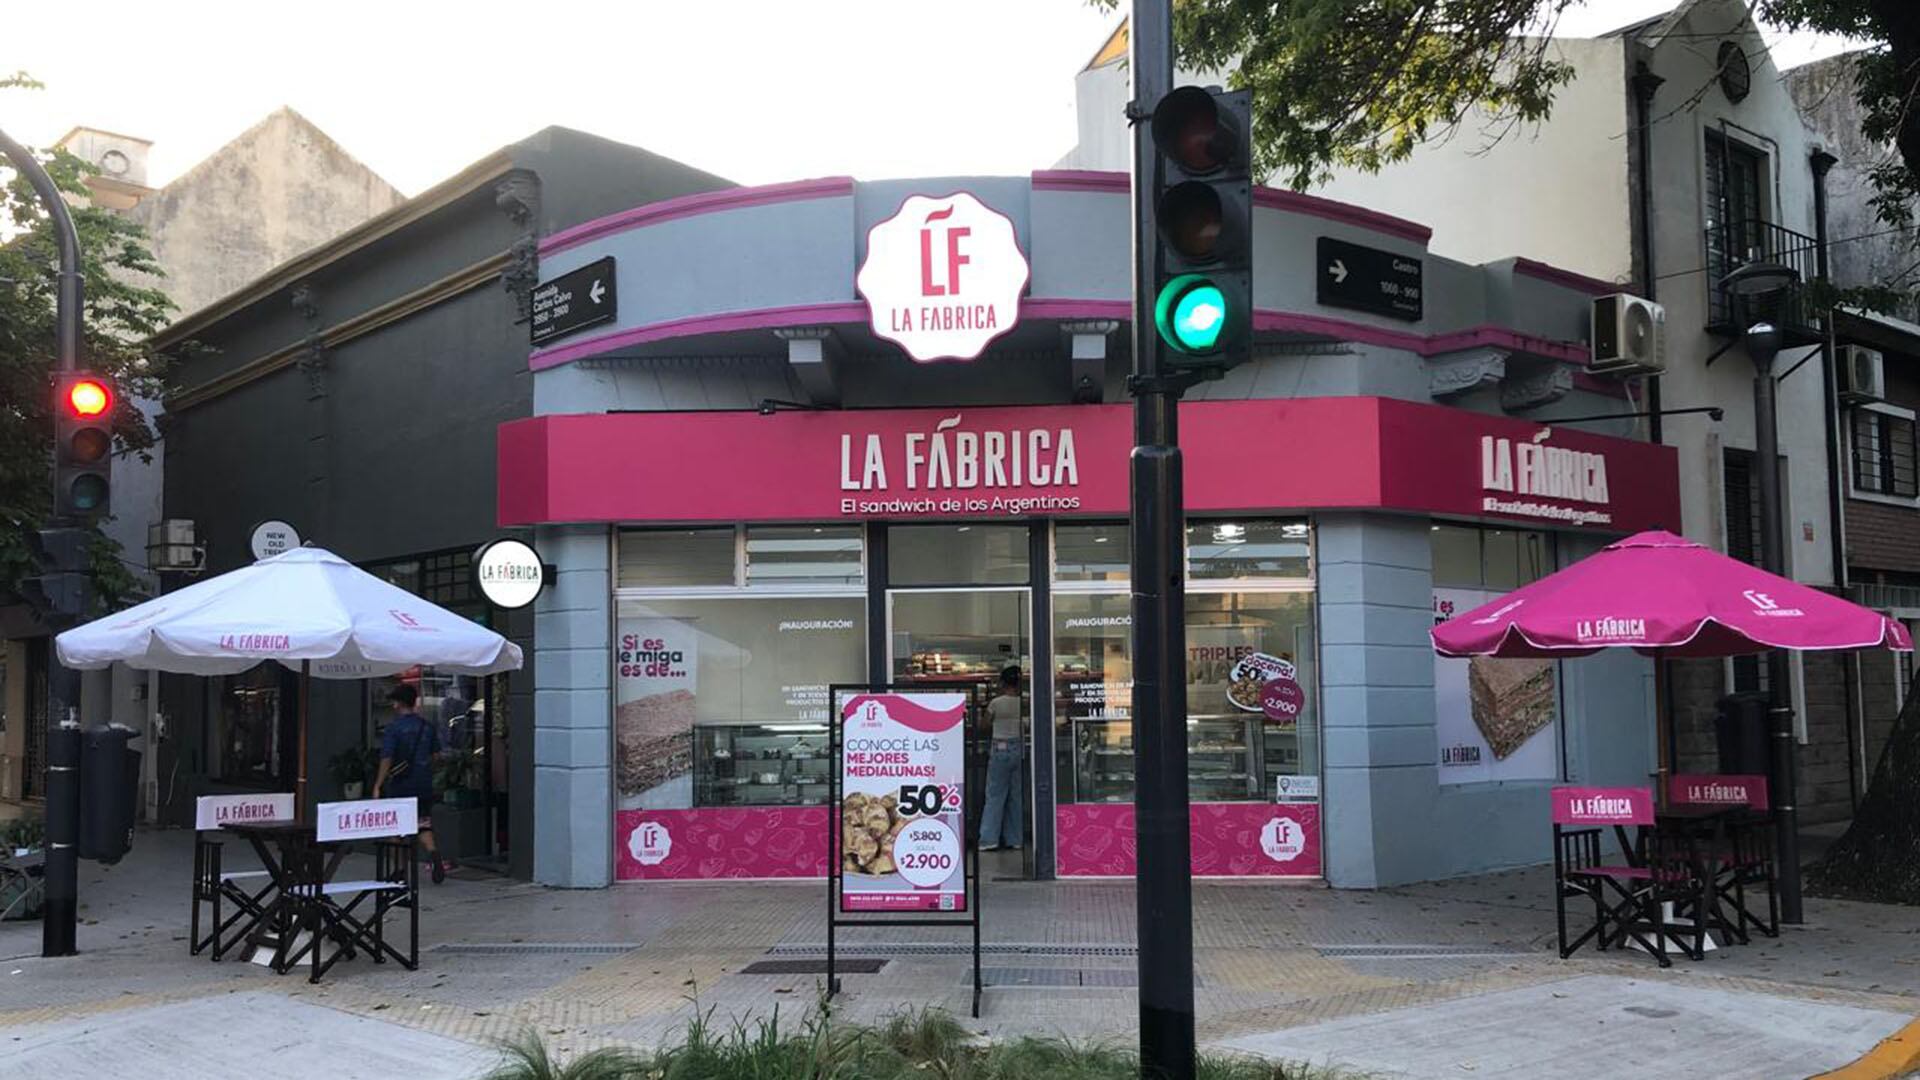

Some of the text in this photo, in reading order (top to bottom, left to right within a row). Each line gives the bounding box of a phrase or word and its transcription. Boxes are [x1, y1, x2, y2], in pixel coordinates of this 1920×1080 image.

[554, 292, 572, 305] Calvo
[891, 304, 997, 332] LA FABRICA
[841, 412, 1079, 490] LA FÁBRICA
[1482, 427, 1609, 504] LA FÁBRICA
[841, 495, 1080, 514] El sandwich de los Argentinos
[268, 540, 285, 548] OLD
[482, 565, 494, 580] LA
[1440, 601, 1454, 613] es
[780, 619, 853, 632] ¡INAUGURACIÓN!
[1066, 615, 1132, 629] ¡INAUGURACIÓ
[1577, 621, 1593, 637] LA
[220, 635, 235, 649] LA
[623, 634, 664, 650] Si es
[636, 647, 683, 667] miga
[1189, 646, 1253, 660] TRIPLES
[621, 662, 687, 677] es de...
[1245, 656, 1294, 678] docena!
[847, 737, 940, 751] CONOCÉ LAS
[847, 753, 909, 764] MEJORES
[1442, 748, 1450, 763] LA
[847, 766, 935, 777] MEDIALUNAS!
[898, 784, 960, 816] 50%
[1689, 786, 1701, 799] LA
[1571, 795, 1632, 814] LA FÁBRICA
[216, 807, 228, 820] LA
[338, 815, 351, 830] LA
[901, 854, 951, 869] $2.900
